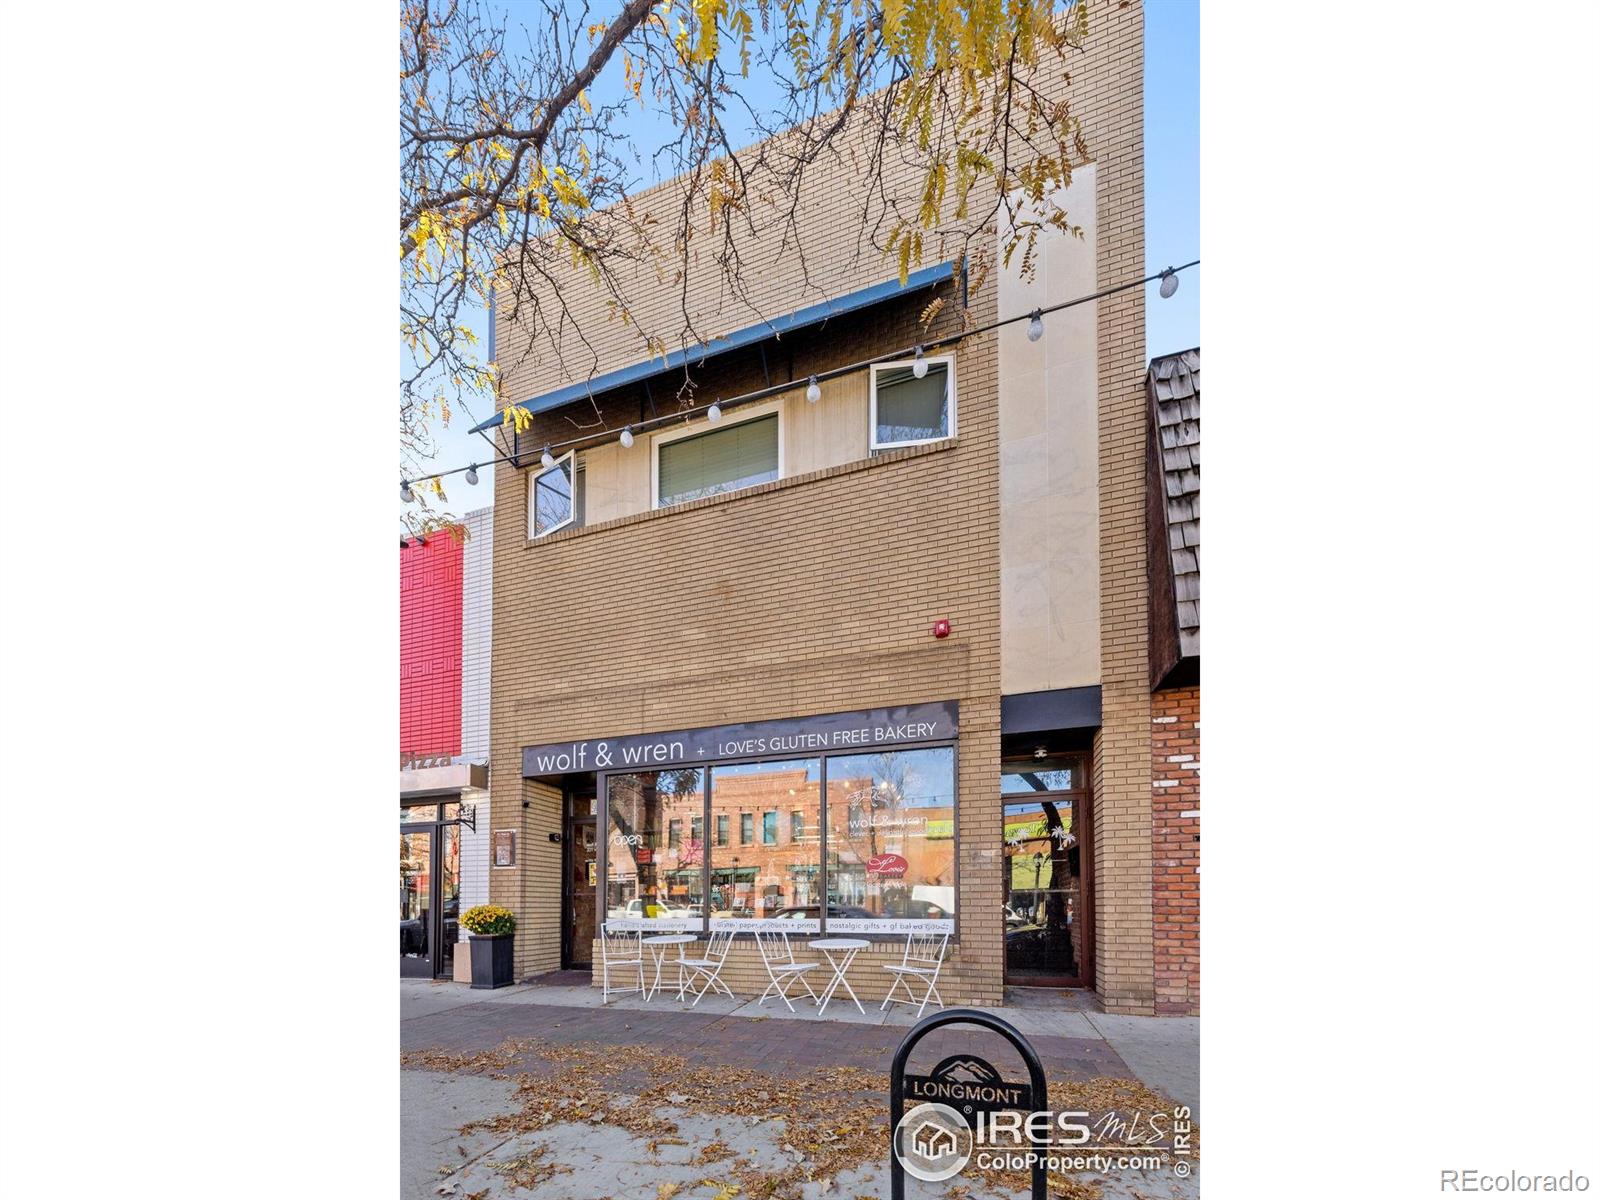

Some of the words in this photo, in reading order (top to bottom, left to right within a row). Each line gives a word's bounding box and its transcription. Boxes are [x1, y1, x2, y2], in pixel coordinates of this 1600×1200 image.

[537, 743, 588, 772] wolf
[595, 742, 613, 767] &
[622, 741, 684, 764] wren
[769, 732, 828, 752] GLUTEN
[833, 728, 870, 744] FREE
[875, 721, 937, 741] BAKERY
[849, 815, 878, 828] wolf
[614, 834, 643, 849] open
[829, 921, 862, 931] nostalgic
[863, 920, 880, 930] gifts
[913, 1081, 1022, 1105] LONGMONT
